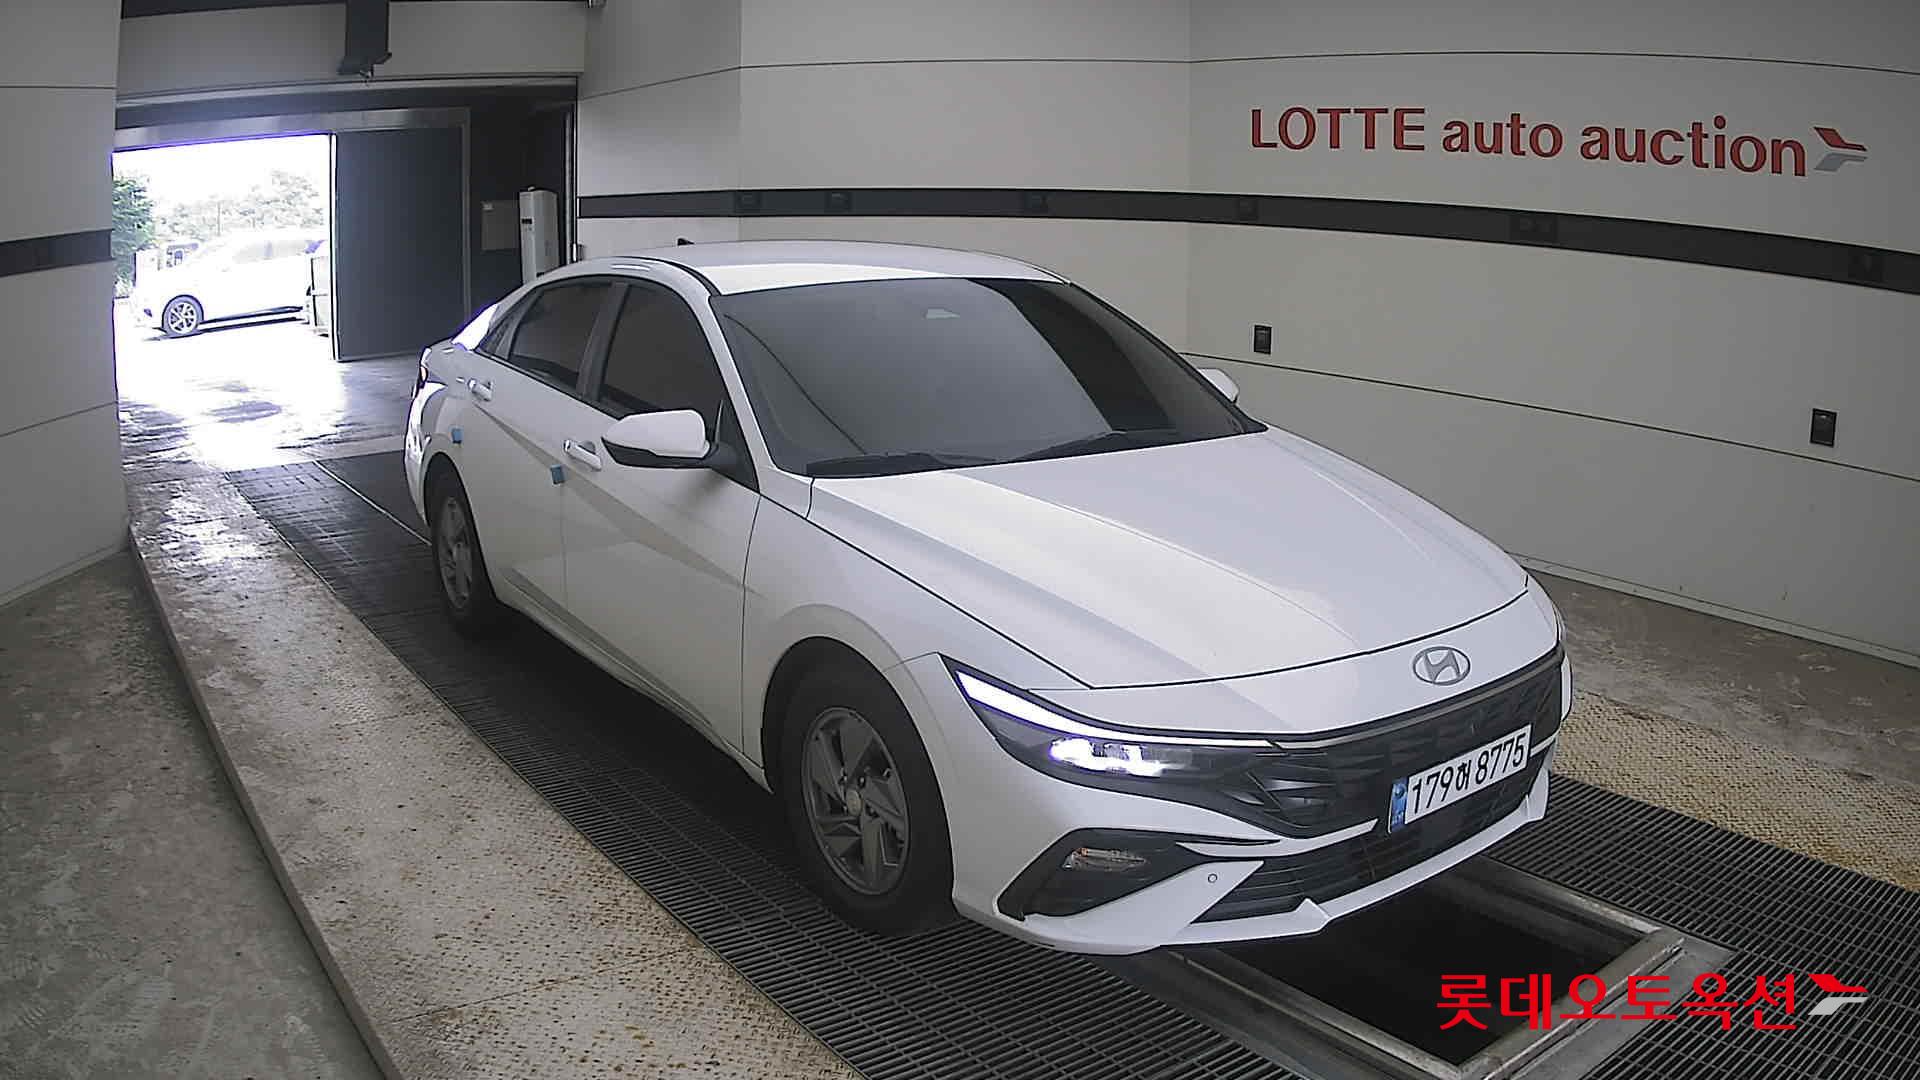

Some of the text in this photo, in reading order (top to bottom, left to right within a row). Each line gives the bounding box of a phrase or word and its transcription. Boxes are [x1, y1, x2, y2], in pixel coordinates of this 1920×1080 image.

[1250, 106, 1807, 177] LOTTE auto auction
[1475, 733, 1527, 785] 8775
